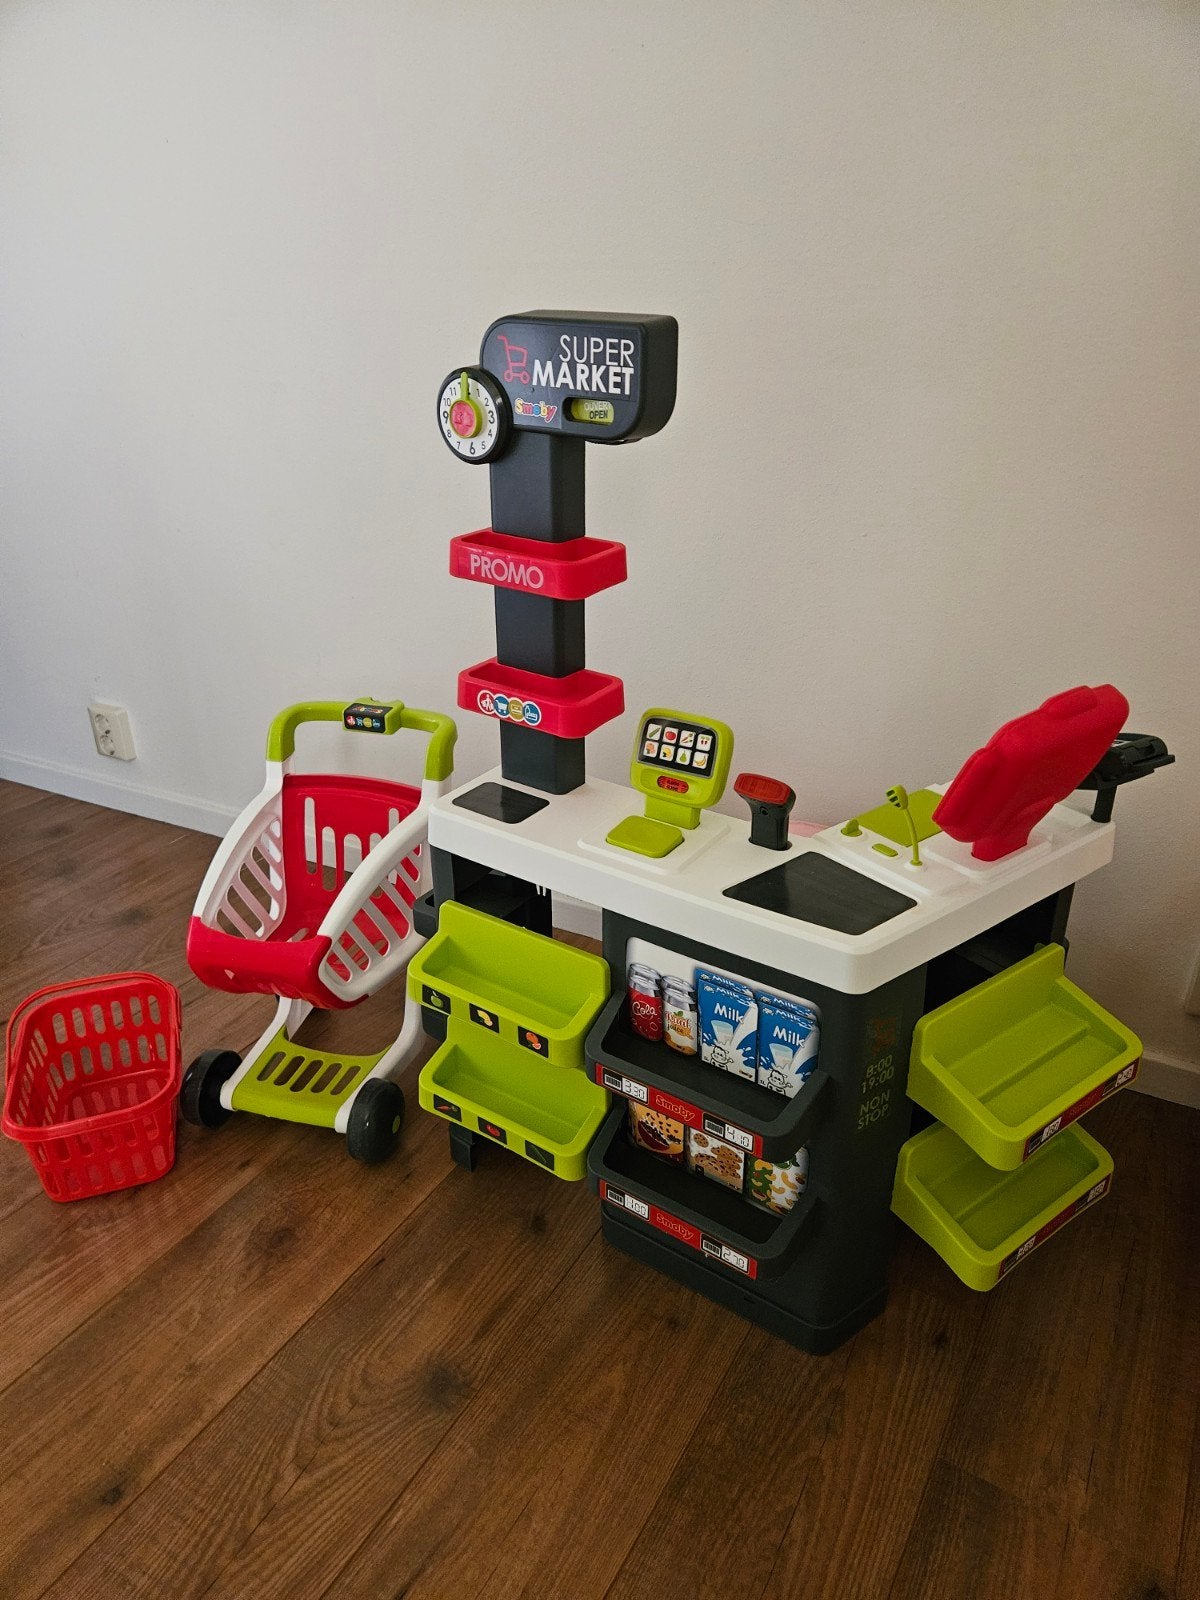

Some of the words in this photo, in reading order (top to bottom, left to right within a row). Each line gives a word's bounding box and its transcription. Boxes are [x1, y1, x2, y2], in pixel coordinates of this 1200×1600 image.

[559, 334, 635, 367] SUPER
[532, 359, 635, 396] MARKET
[449, 387, 457, 396] 11
[476, 388, 481, 398] 1
[443, 397, 451, 407] 10
[484, 397, 490, 407] 2
[442, 410, 449, 425] 9
[487, 410, 495, 425] 3
[514, 397, 558, 423] Smoby
[589, 409, 609, 420] OPEN
[446, 429, 452, 439] 8
[487, 428, 493, 438] 4
[456, 441, 461, 450] 7
[469, 441, 476, 455] 6
[481, 440, 486, 450] 5
[470, 553, 545, 589] PROMO
[632, 1001, 658, 1020] Cola
[714, 1002, 744, 1025] Milk
[772, 1025, 806, 1048] Milk
[655, 1094, 696, 1121] Smoby
[860, 1089, 890, 1116] NON
[857, 1103, 889, 1130] STOP
[656, 1212, 694, 1241] Smoby
